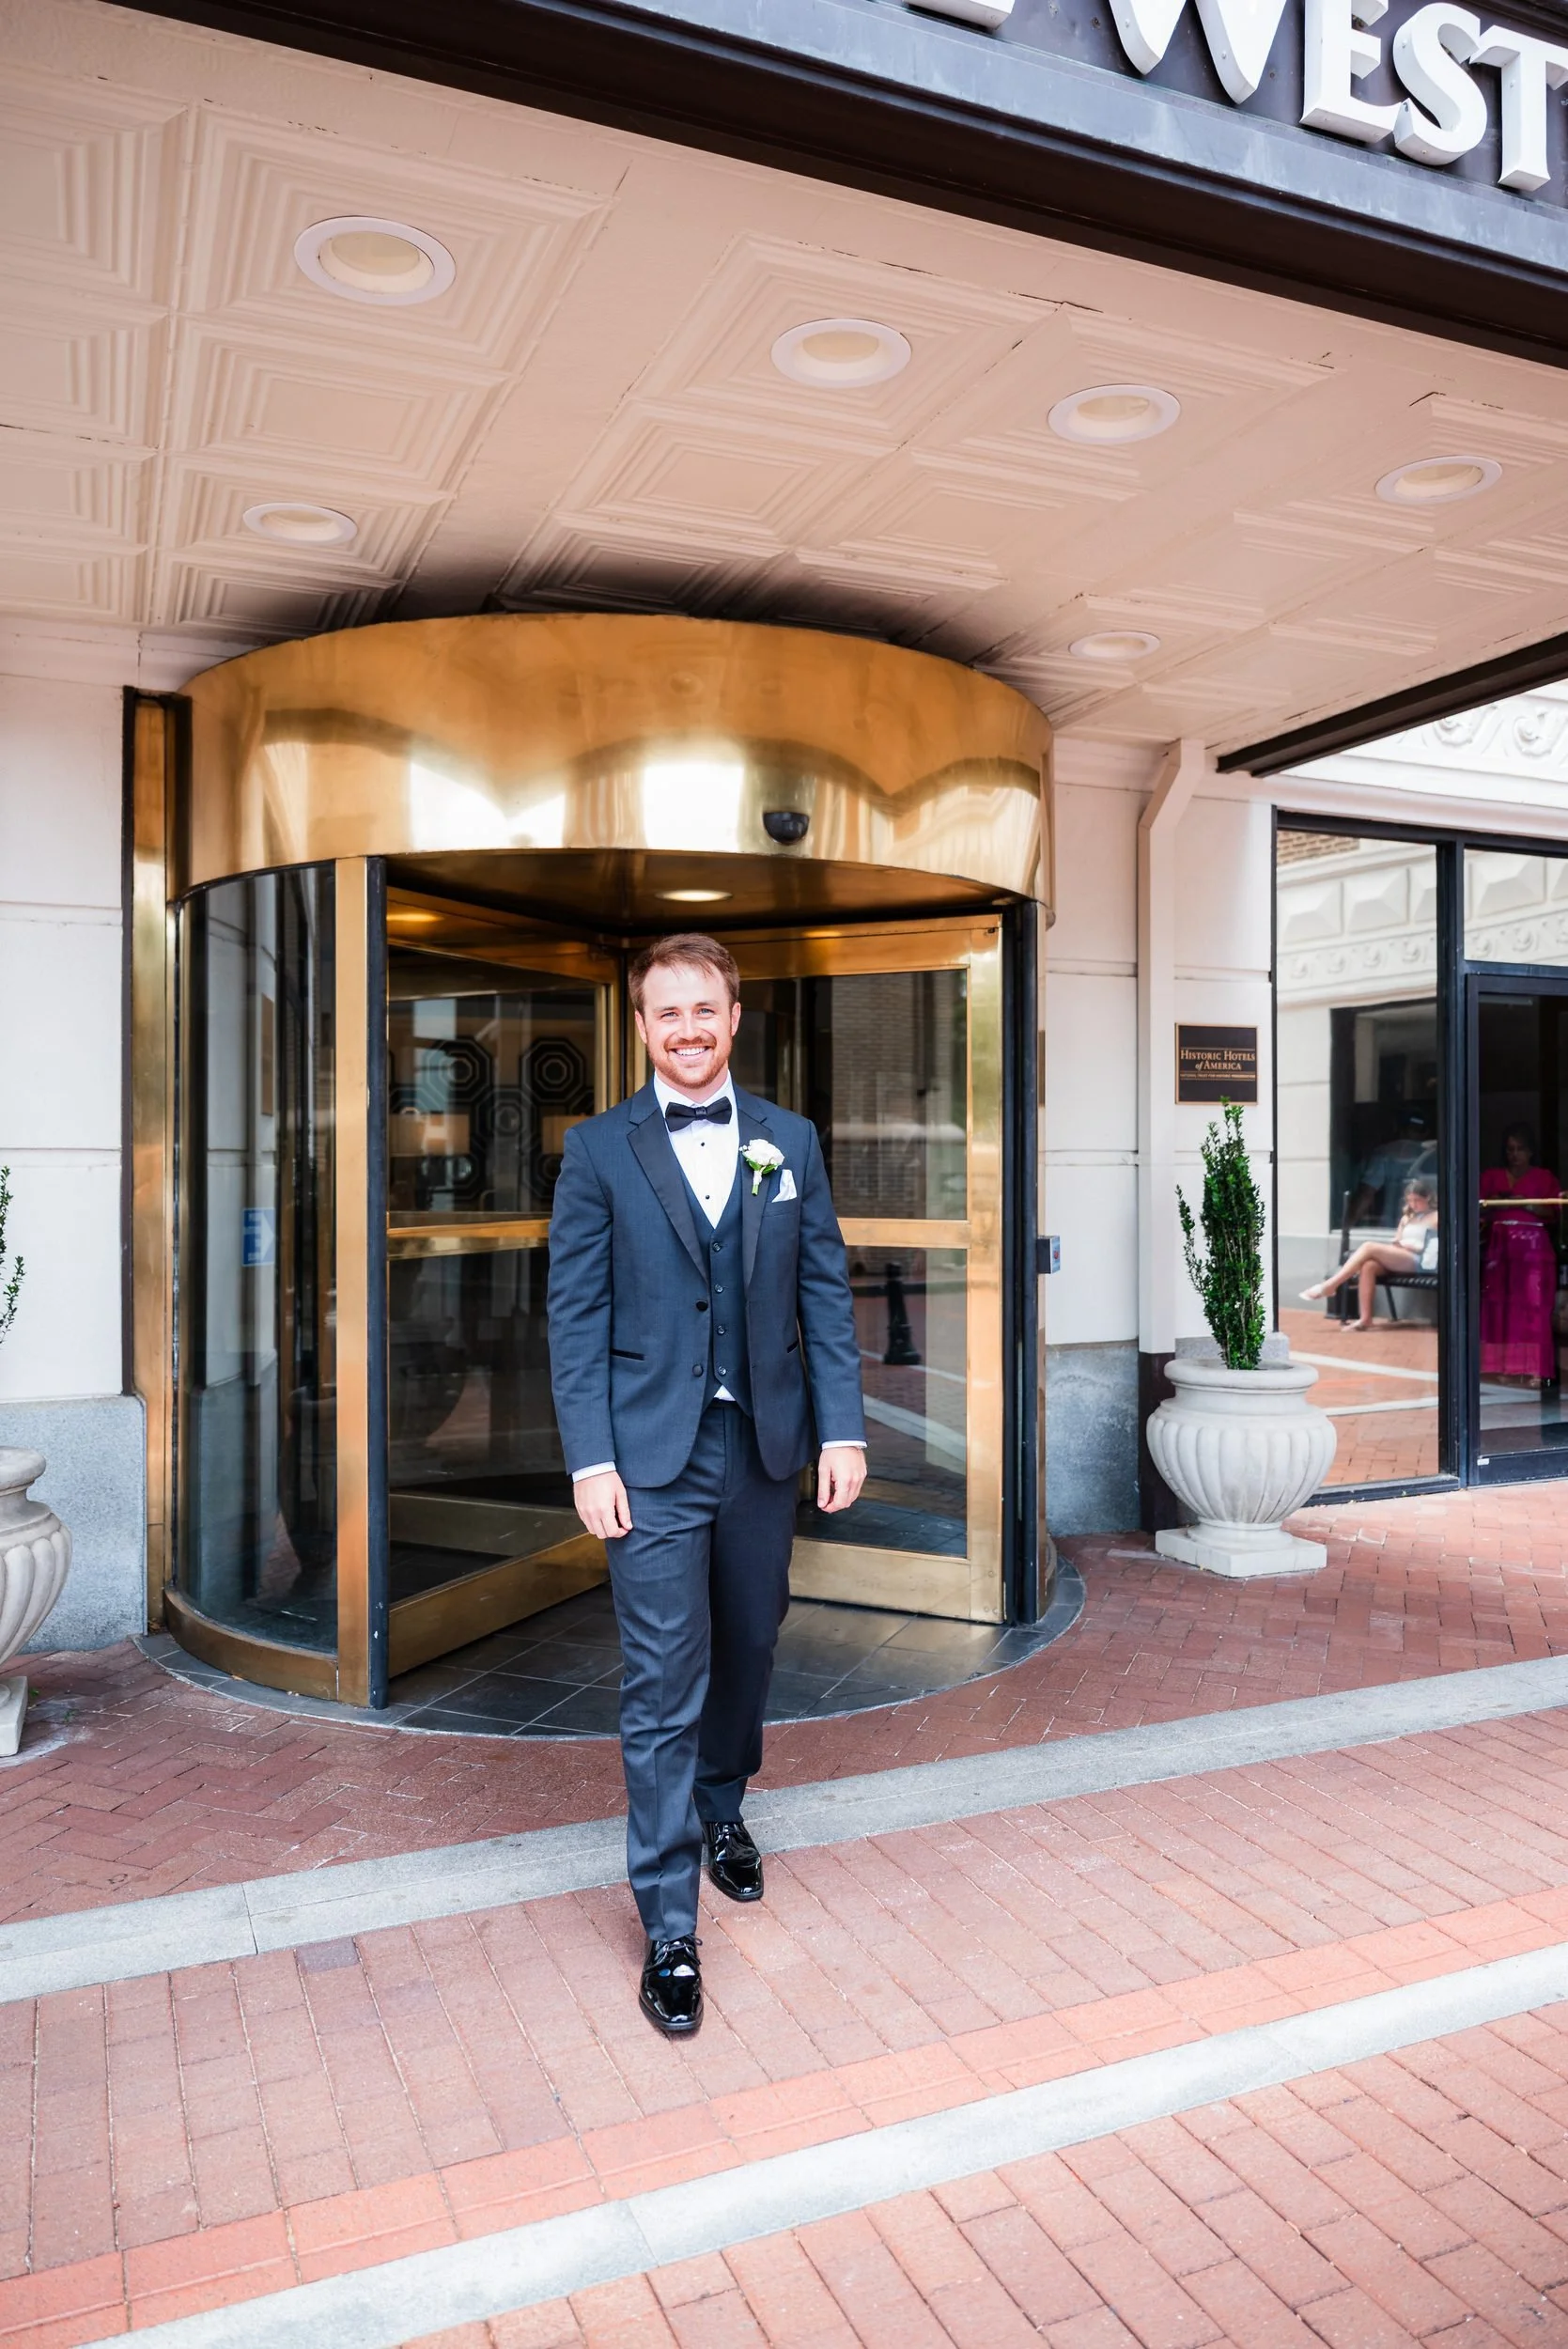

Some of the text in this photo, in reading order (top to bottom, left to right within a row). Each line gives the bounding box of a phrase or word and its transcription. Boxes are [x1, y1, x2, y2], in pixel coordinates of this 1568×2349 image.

[1180, 1050, 1255, 1061] HISTORIC HOTELS
[1203, 1060, 1241, 1070] AMERICA
